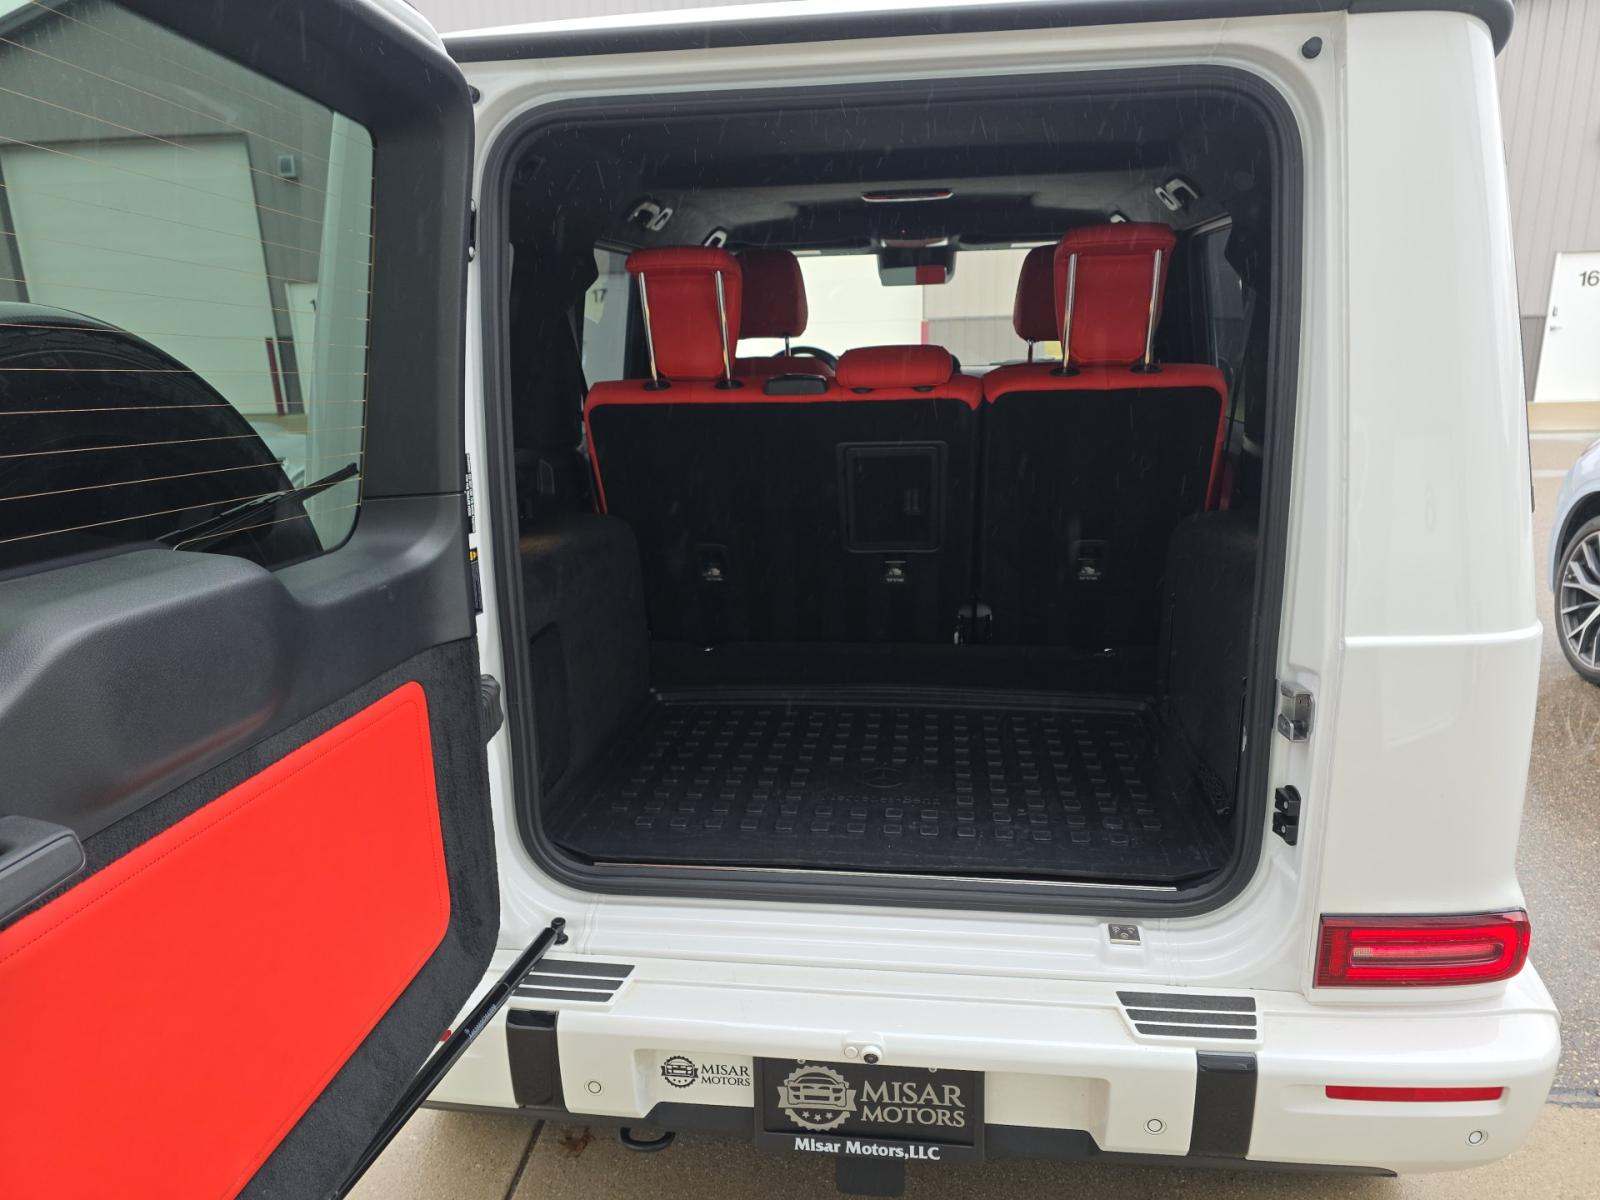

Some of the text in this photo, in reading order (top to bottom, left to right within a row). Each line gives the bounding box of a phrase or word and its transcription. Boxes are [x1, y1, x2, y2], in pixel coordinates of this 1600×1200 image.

[1579, 270, 1600, 287] 16
[592, 288, 608, 303] 17
[701, 1064, 750, 1077] MISAR
[701, 1076, 751, 1087] MOTORS
[860, 1080, 966, 1108] MISAR
[861, 1105, 966, 1128] MOTORS
